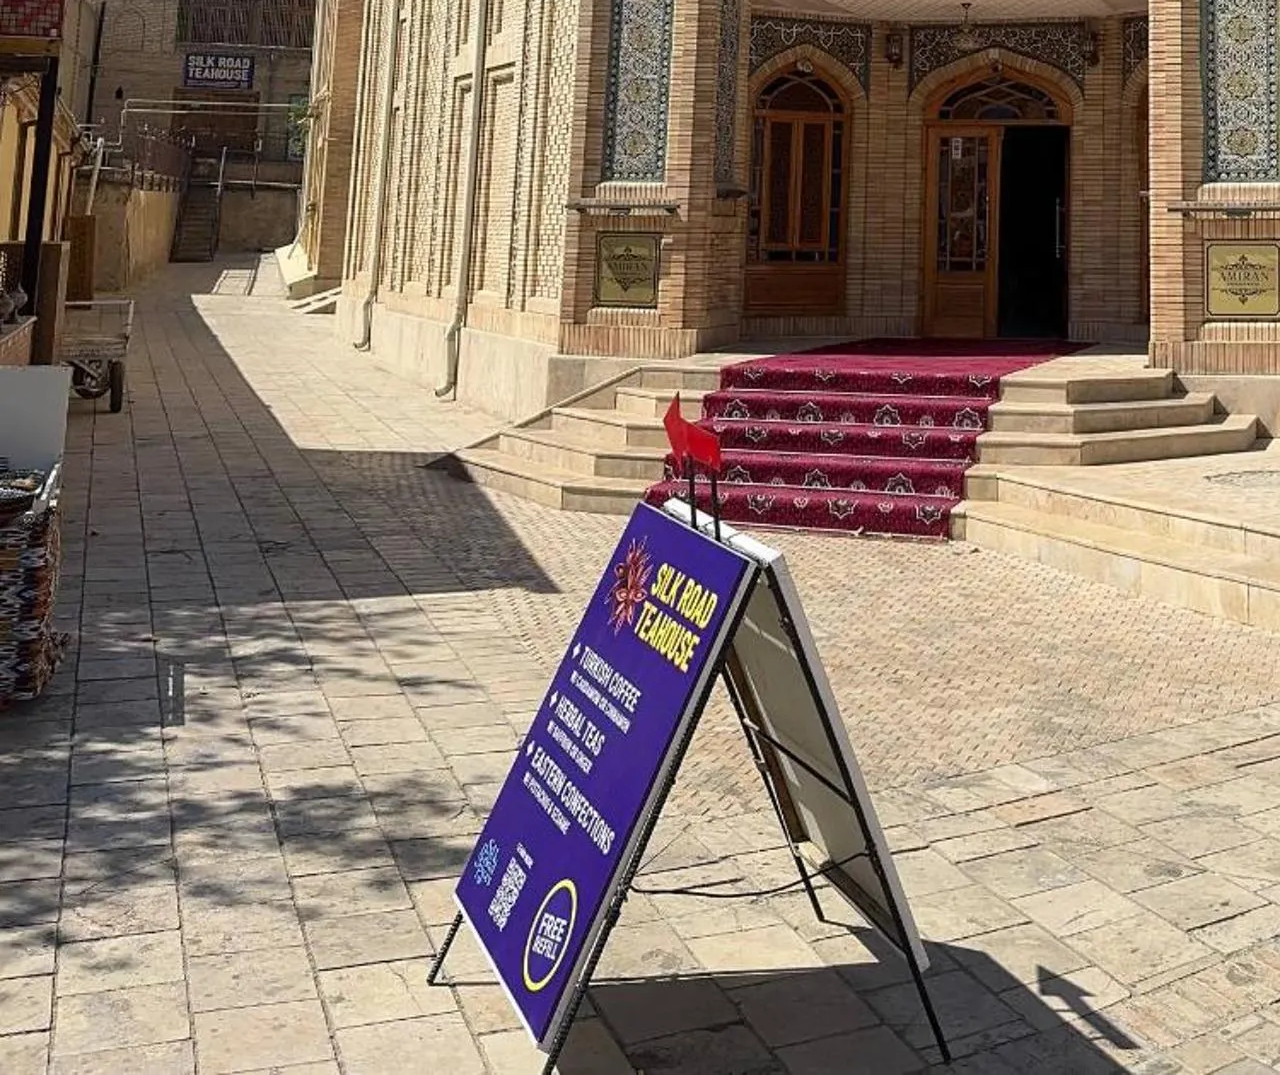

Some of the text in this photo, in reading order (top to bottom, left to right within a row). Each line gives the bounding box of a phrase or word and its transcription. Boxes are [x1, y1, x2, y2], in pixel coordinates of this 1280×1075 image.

[188, 55, 250, 69] SILK ROAD
[188, 67, 249, 81] TEAHOUSE
[651, 563, 718, 629] SILK ROAD
[634, 600, 701, 673] TEAHOUSE
[580, 645, 642, 713] TURKISH COFFEE
[554, 694, 605, 756] HERBAL TEAS
[531, 746, 615, 855] EASTERN CONFECTIONS
[532, 934, 560, 961] REFILL
[537, 912, 568, 943] FREE
